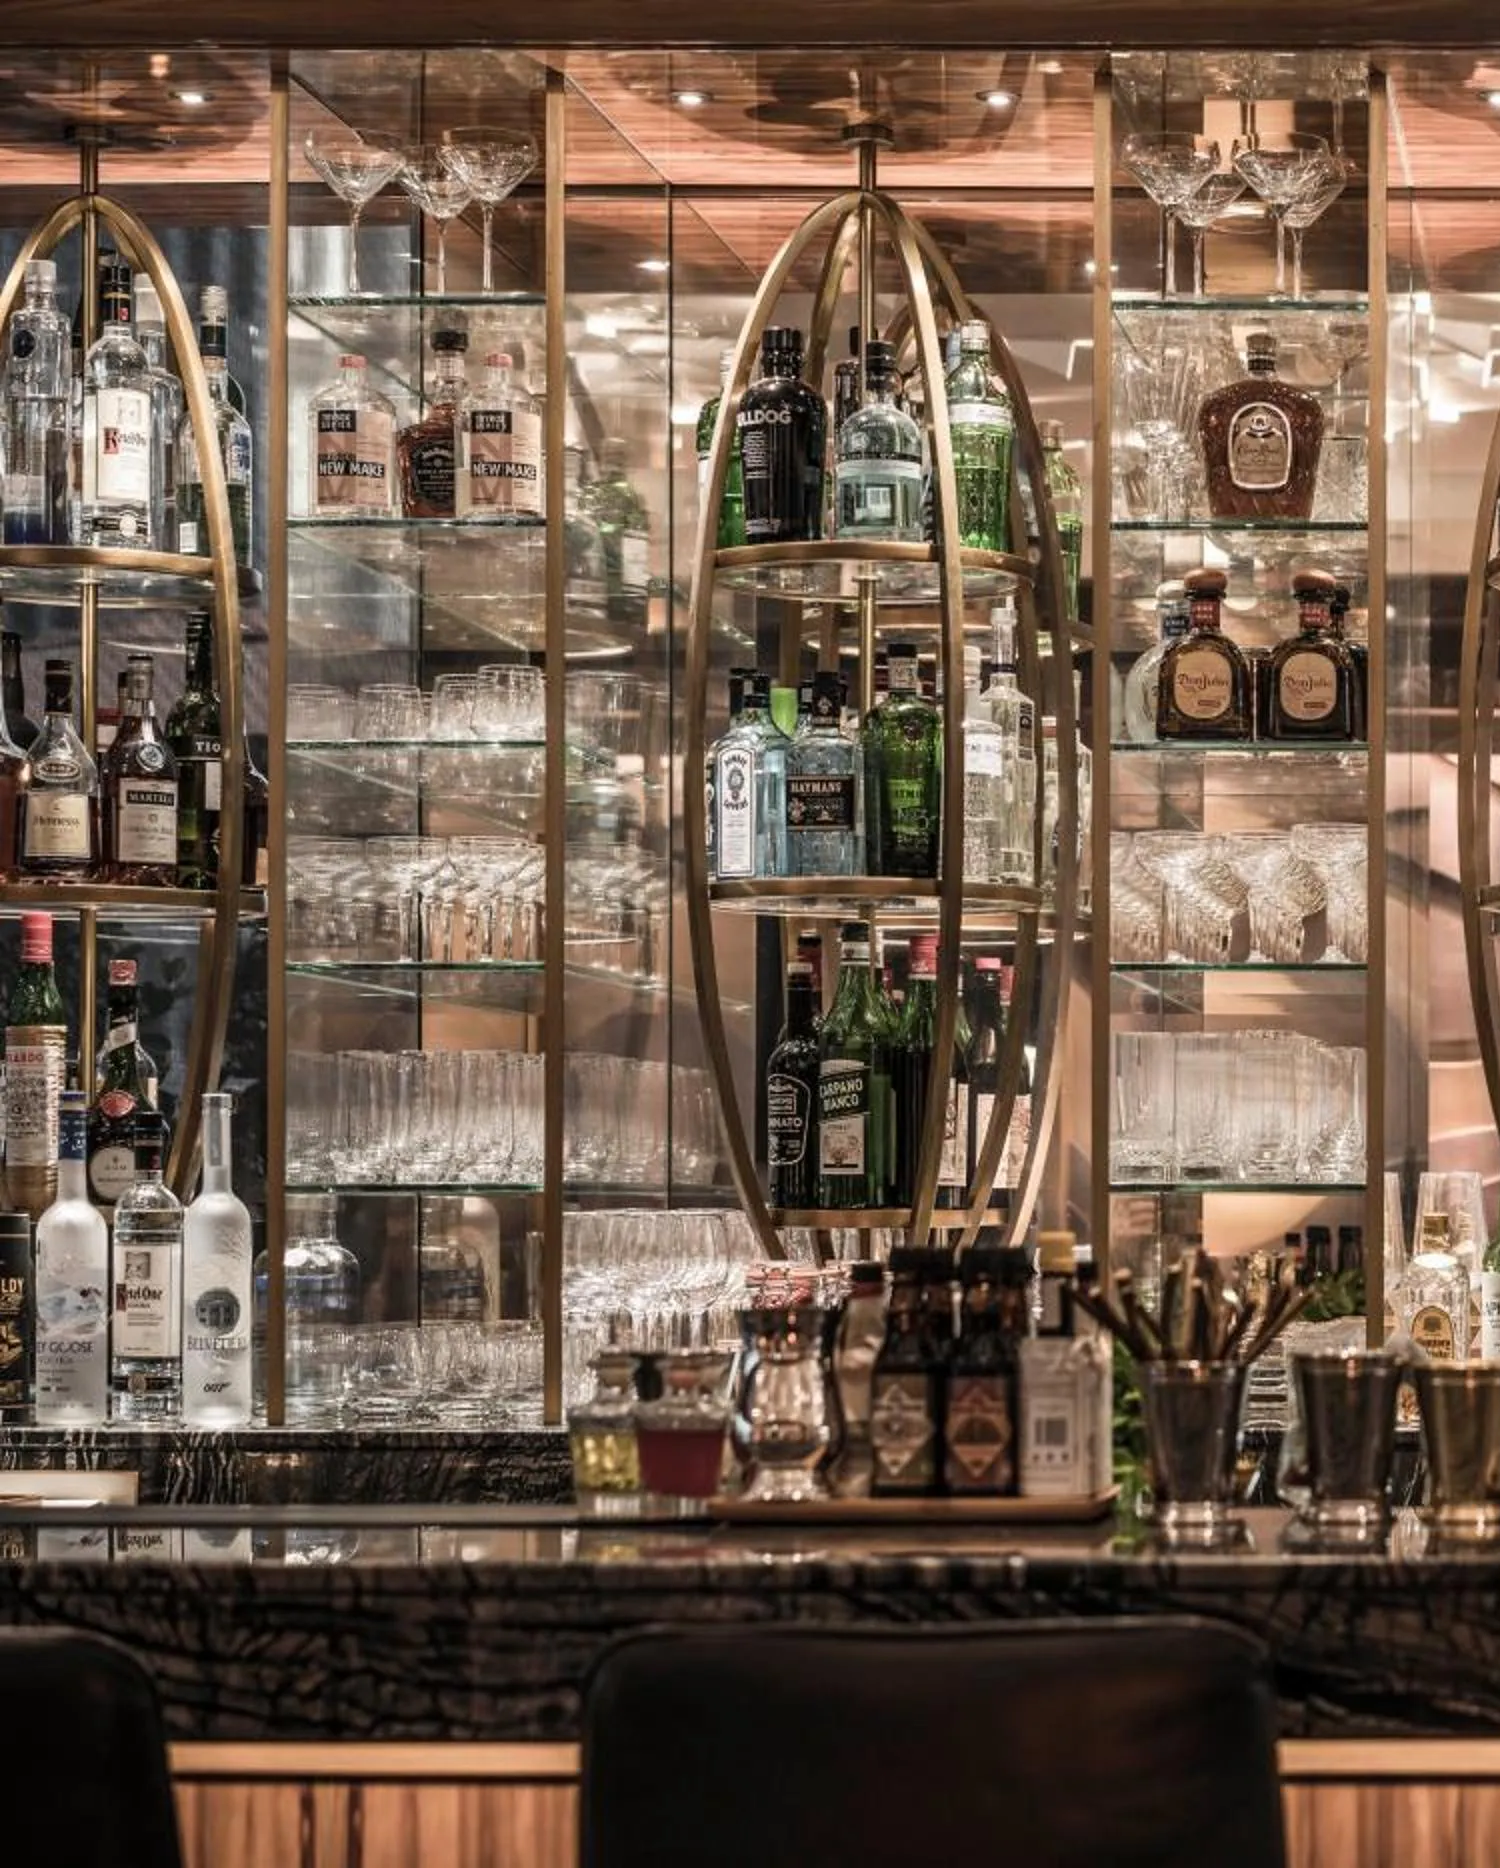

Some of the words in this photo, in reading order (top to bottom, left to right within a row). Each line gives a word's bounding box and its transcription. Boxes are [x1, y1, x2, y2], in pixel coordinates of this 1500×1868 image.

[320, 461, 345, 475] NEW
[349, 462, 384, 477] MAKE
[474, 463, 501, 477] NEW
[505, 463, 537, 479] MAKE
